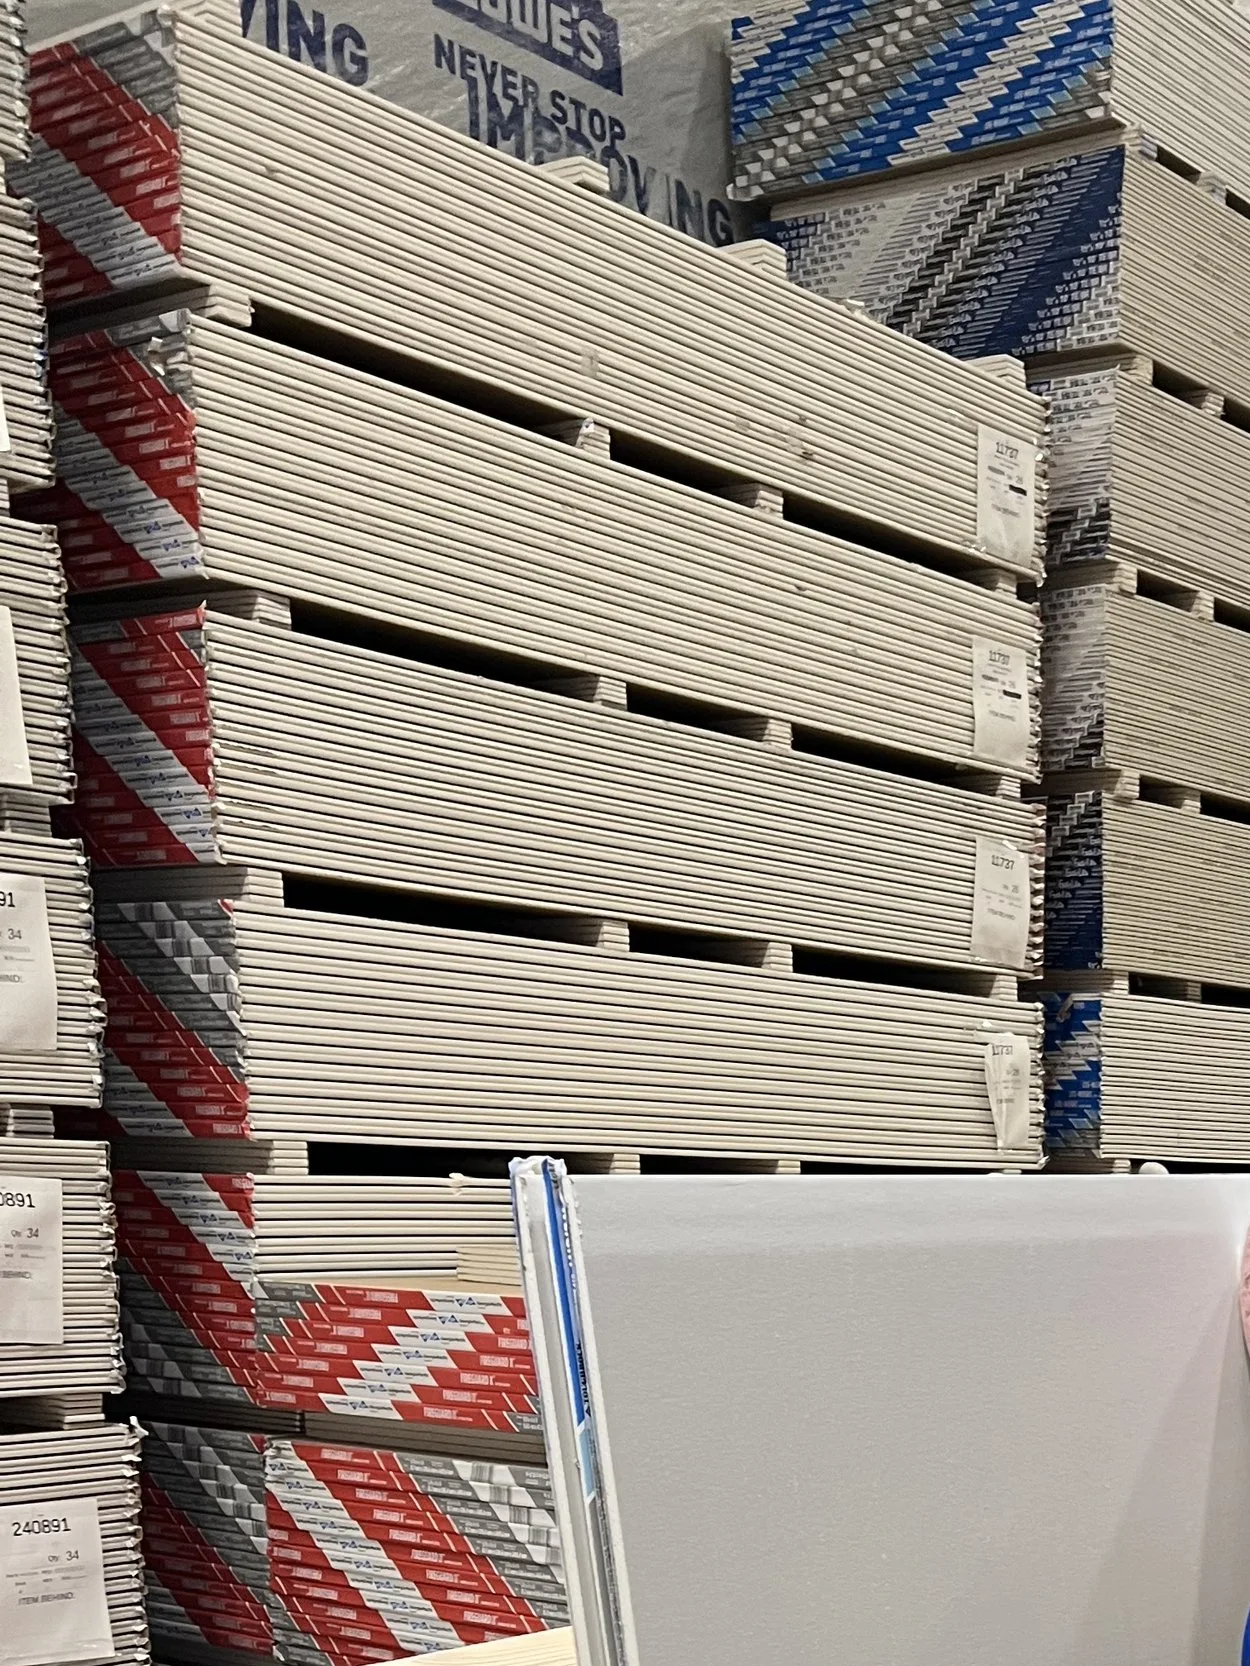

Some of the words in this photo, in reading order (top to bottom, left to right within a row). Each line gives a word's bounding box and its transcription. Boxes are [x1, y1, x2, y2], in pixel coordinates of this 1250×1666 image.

[433, 33, 540, 109] NEVER
[550, 89, 626, 148] STOP
[991, 854, 1015, 871] 11737
[8, 928, 22, 940] 34
[26, 1227, 39, 1239] 34
[12, 1517, 71, 1537] 240891
[65, 1549, 79, 1561] 34
